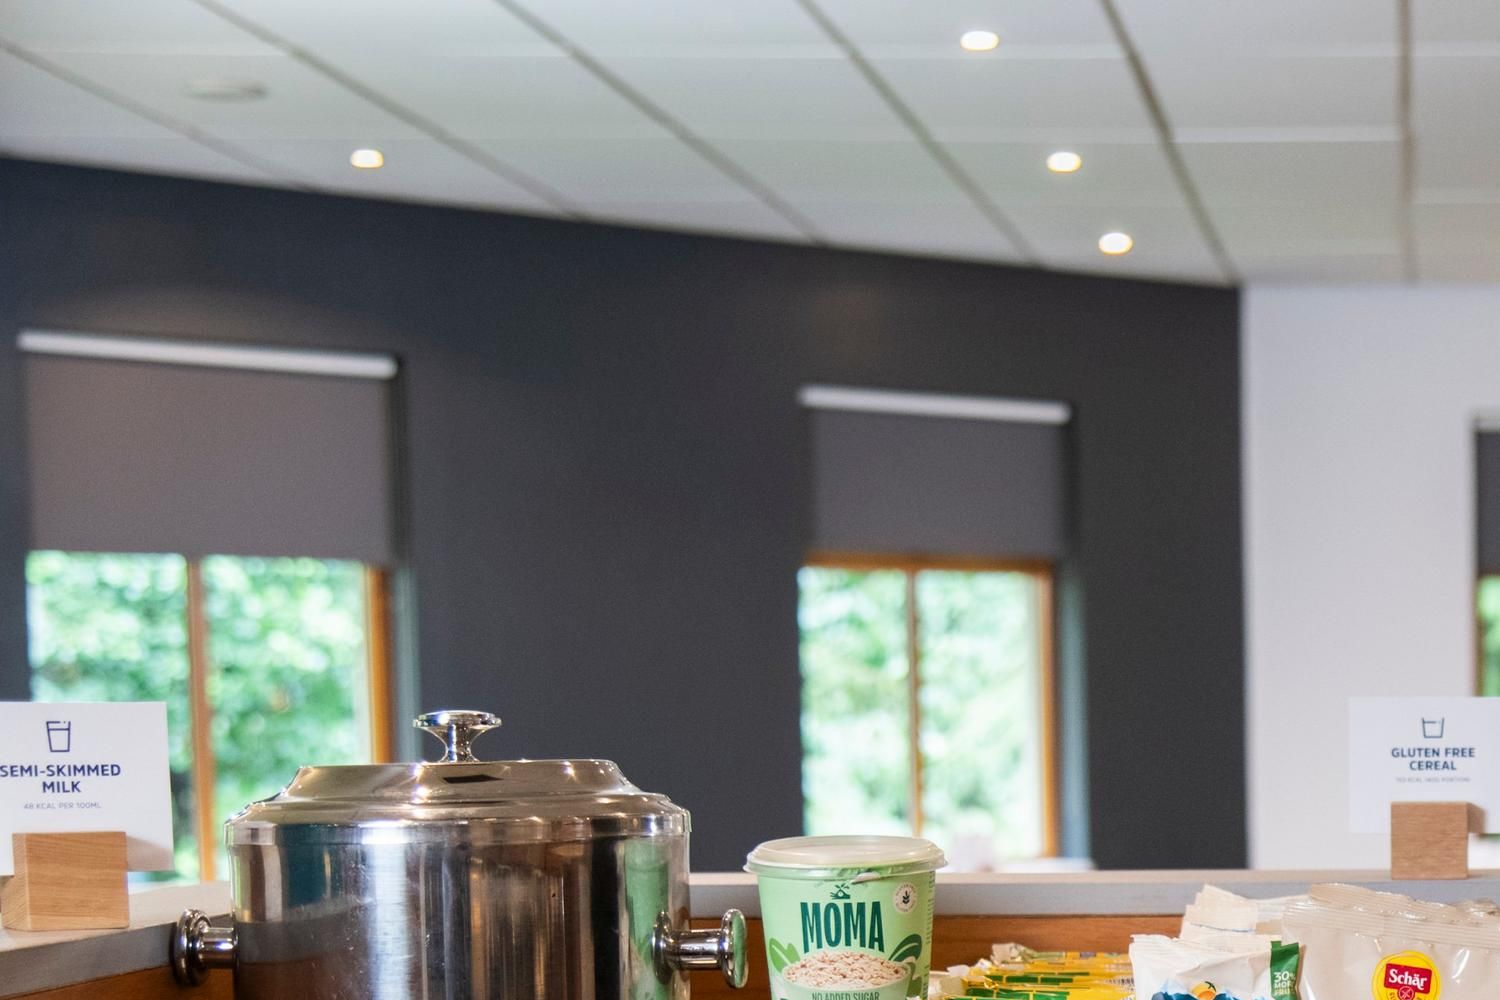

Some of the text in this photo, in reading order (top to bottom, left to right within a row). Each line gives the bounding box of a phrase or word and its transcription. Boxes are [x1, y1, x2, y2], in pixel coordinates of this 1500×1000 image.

[1391, 747, 1476, 758] GLUTEN FREE
[0, 764, 121, 777] SEMI-SKIMMED
[1409, 760, 1457, 771] CEREAL
[42, 781, 81, 793] MILK
[800, 901, 885, 953] MOMA
[1388, 968, 1428, 991] Schär
